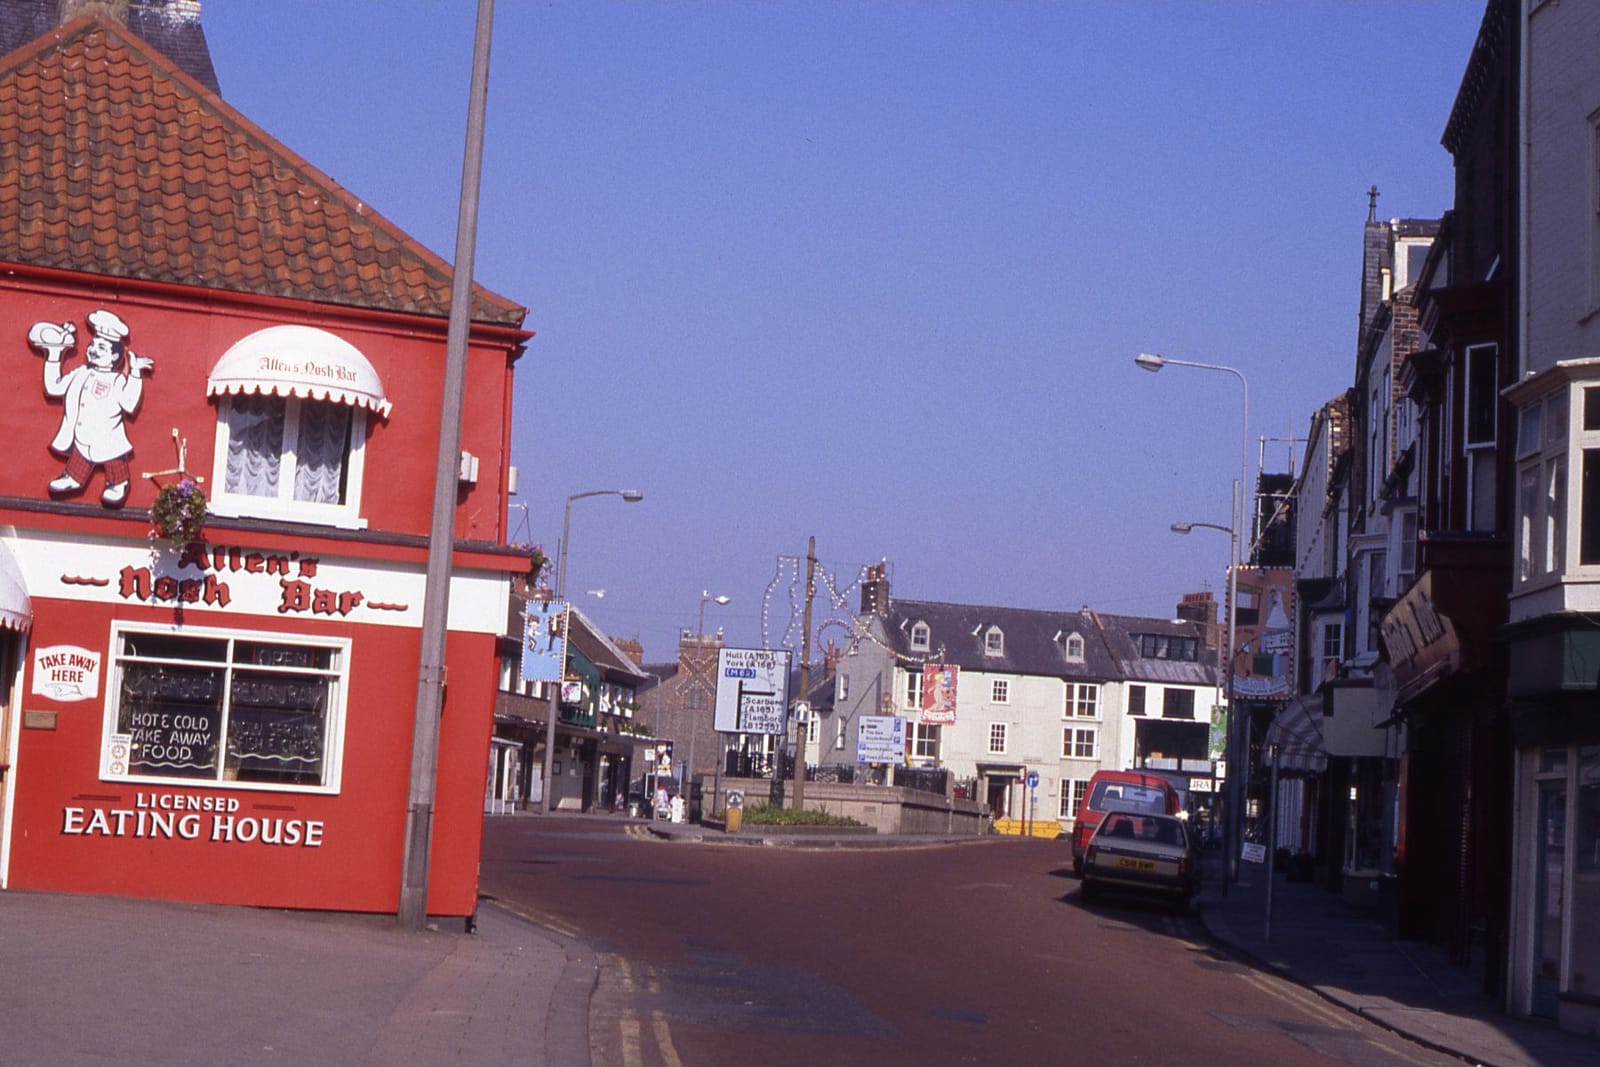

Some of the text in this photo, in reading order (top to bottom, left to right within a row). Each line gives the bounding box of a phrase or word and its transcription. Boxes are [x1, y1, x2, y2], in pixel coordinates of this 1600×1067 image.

[300, 360, 334, 379] Nosh
[335, 364, 357, 383] Bar
[178, 543, 320, 578] Allen's
[119, 565, 365, 617] Nosh Bar
[38, 653, 98, 673] TAKE AWAY
[725, 651, 742, 659] Hull
[51, 669, 84, 683] HERE
[131, 712, 159, 727] HOT
[174, 715, 209, 732] COLD
[128, 728, 162, 744] TAKE
[169, 731, 211, 746] AWAY
[136, 792, 240, 813] LICENSED
[62, 806, 325, 847] EATING HOUSE
